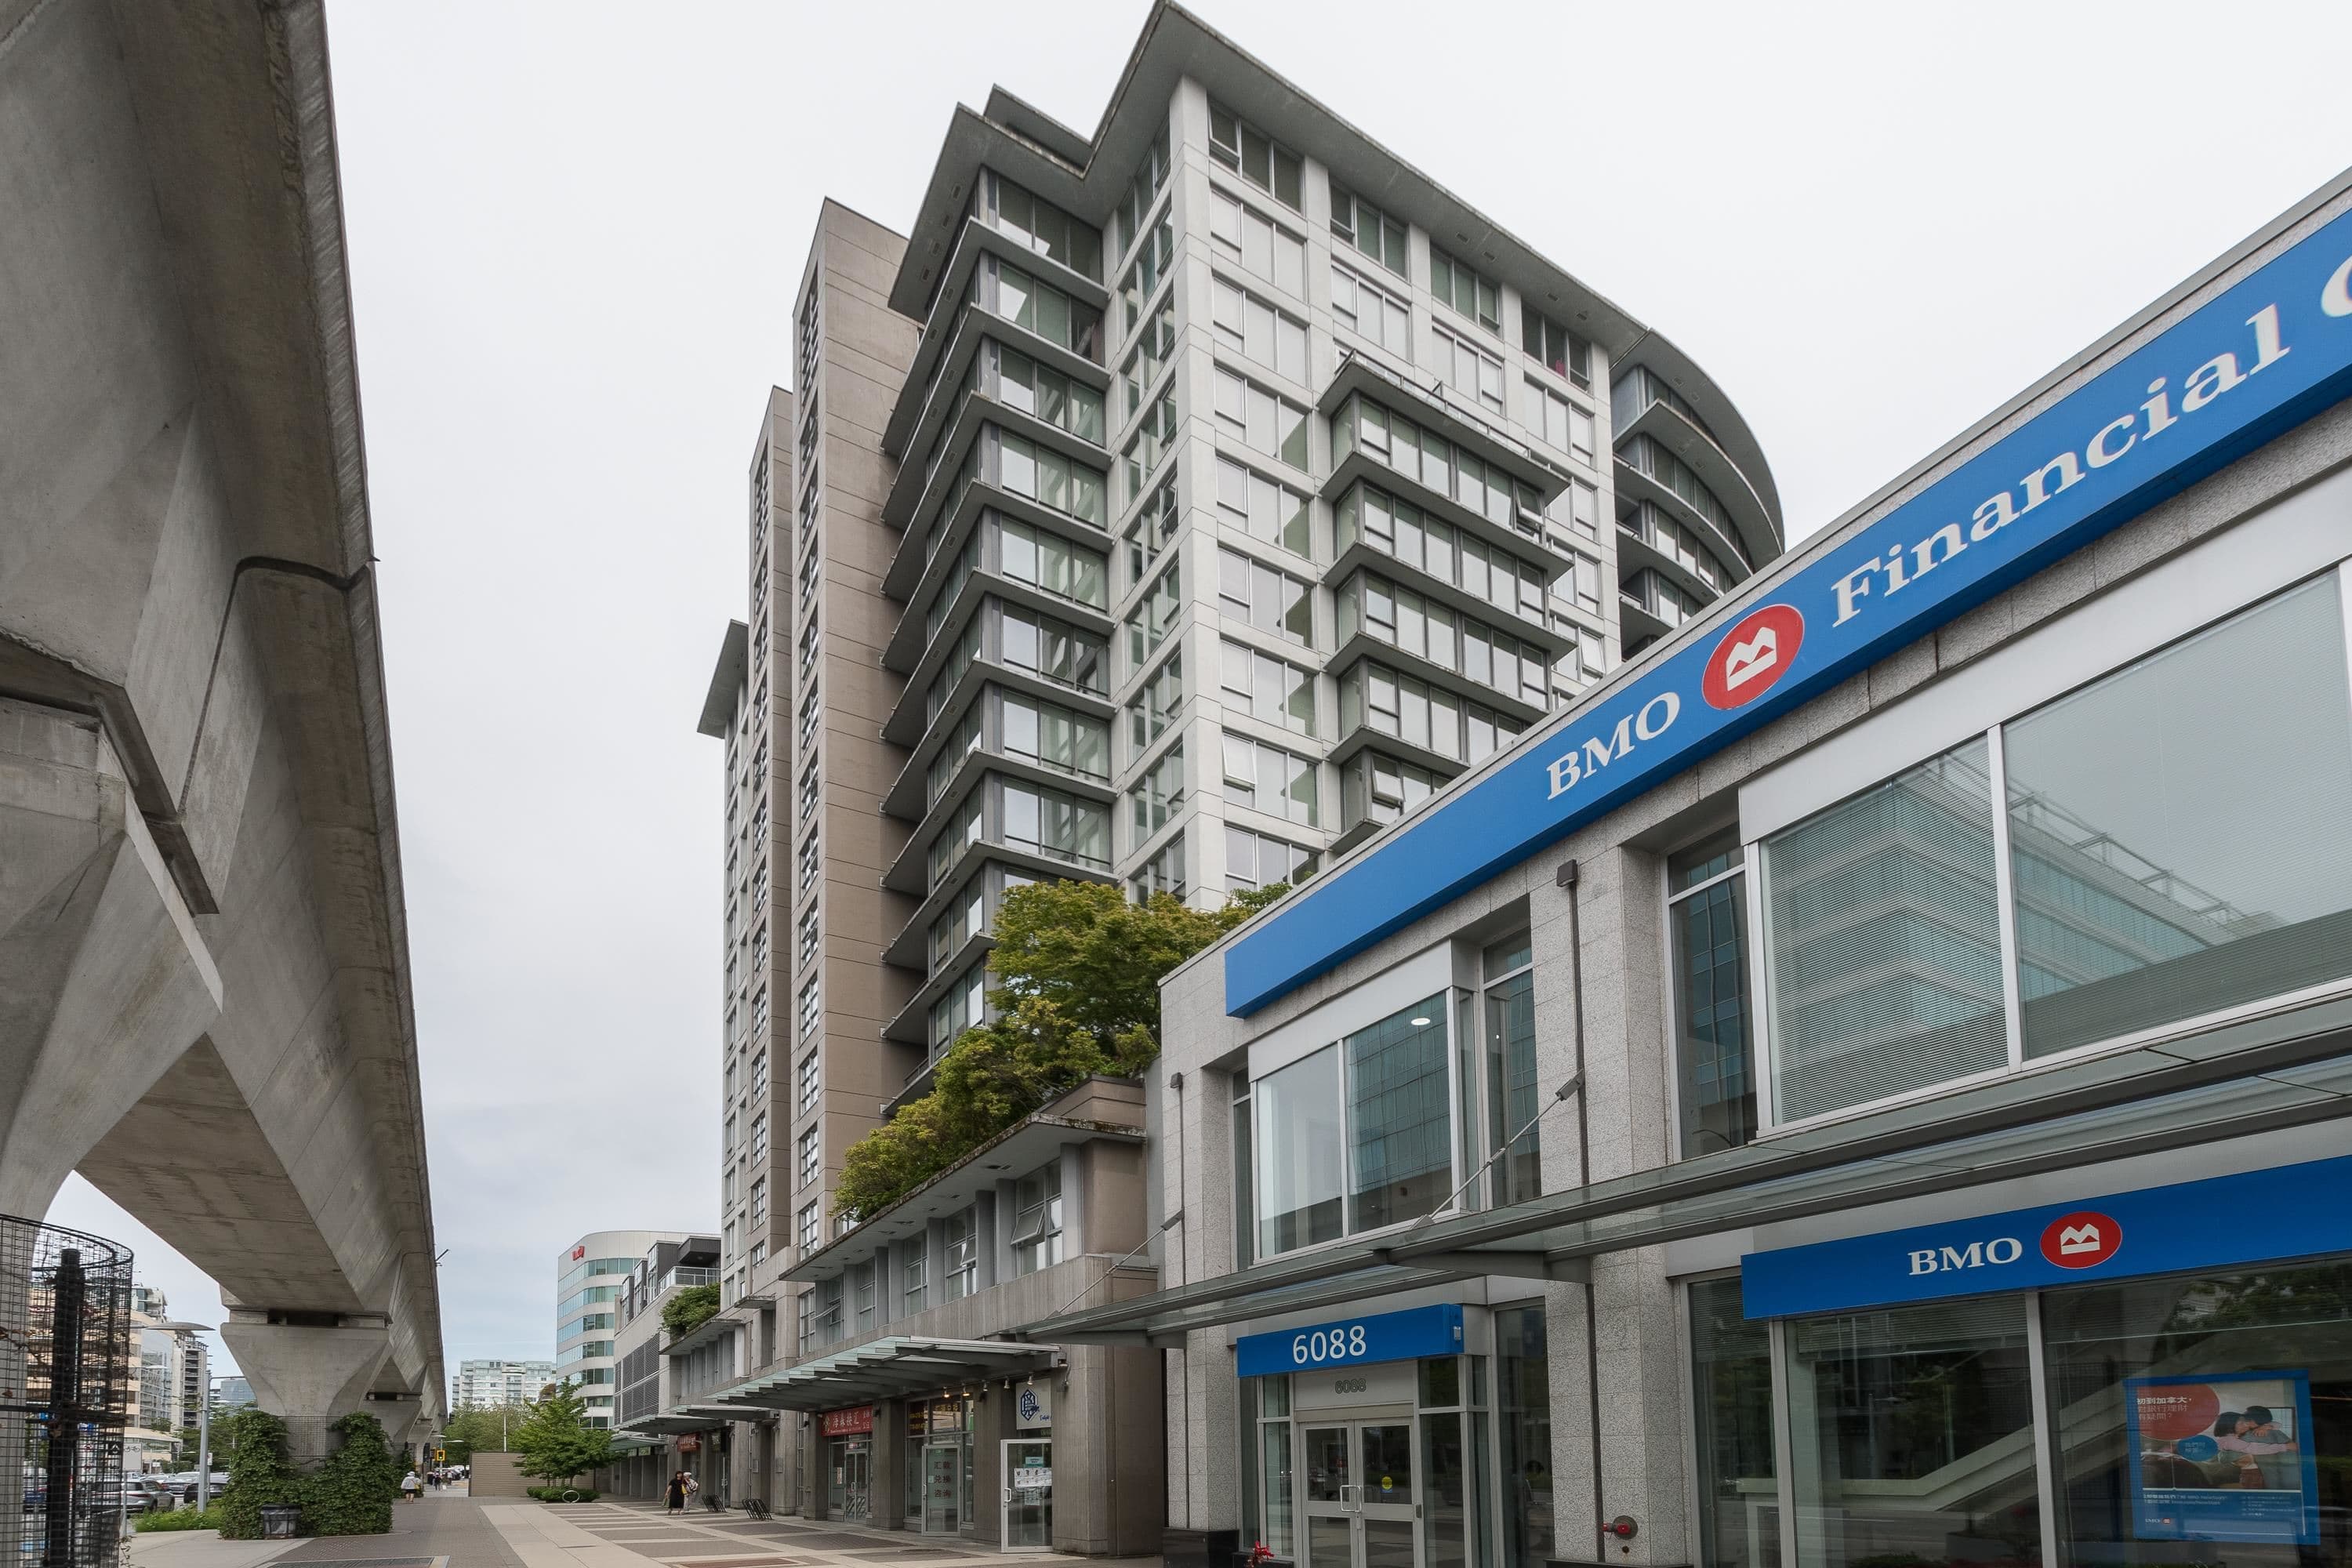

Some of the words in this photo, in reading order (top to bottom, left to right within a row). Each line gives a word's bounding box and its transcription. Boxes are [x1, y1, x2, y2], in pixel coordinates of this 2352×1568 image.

[1546, 691, 1681, 800] BMO
[1831, 303, 2291, 628] Financial
[1907, 1237, 2023, 1276] BMO
[1293, 1326, 1367, 1364] 6088
[1334, 1377, 1367, 1394] 6088
